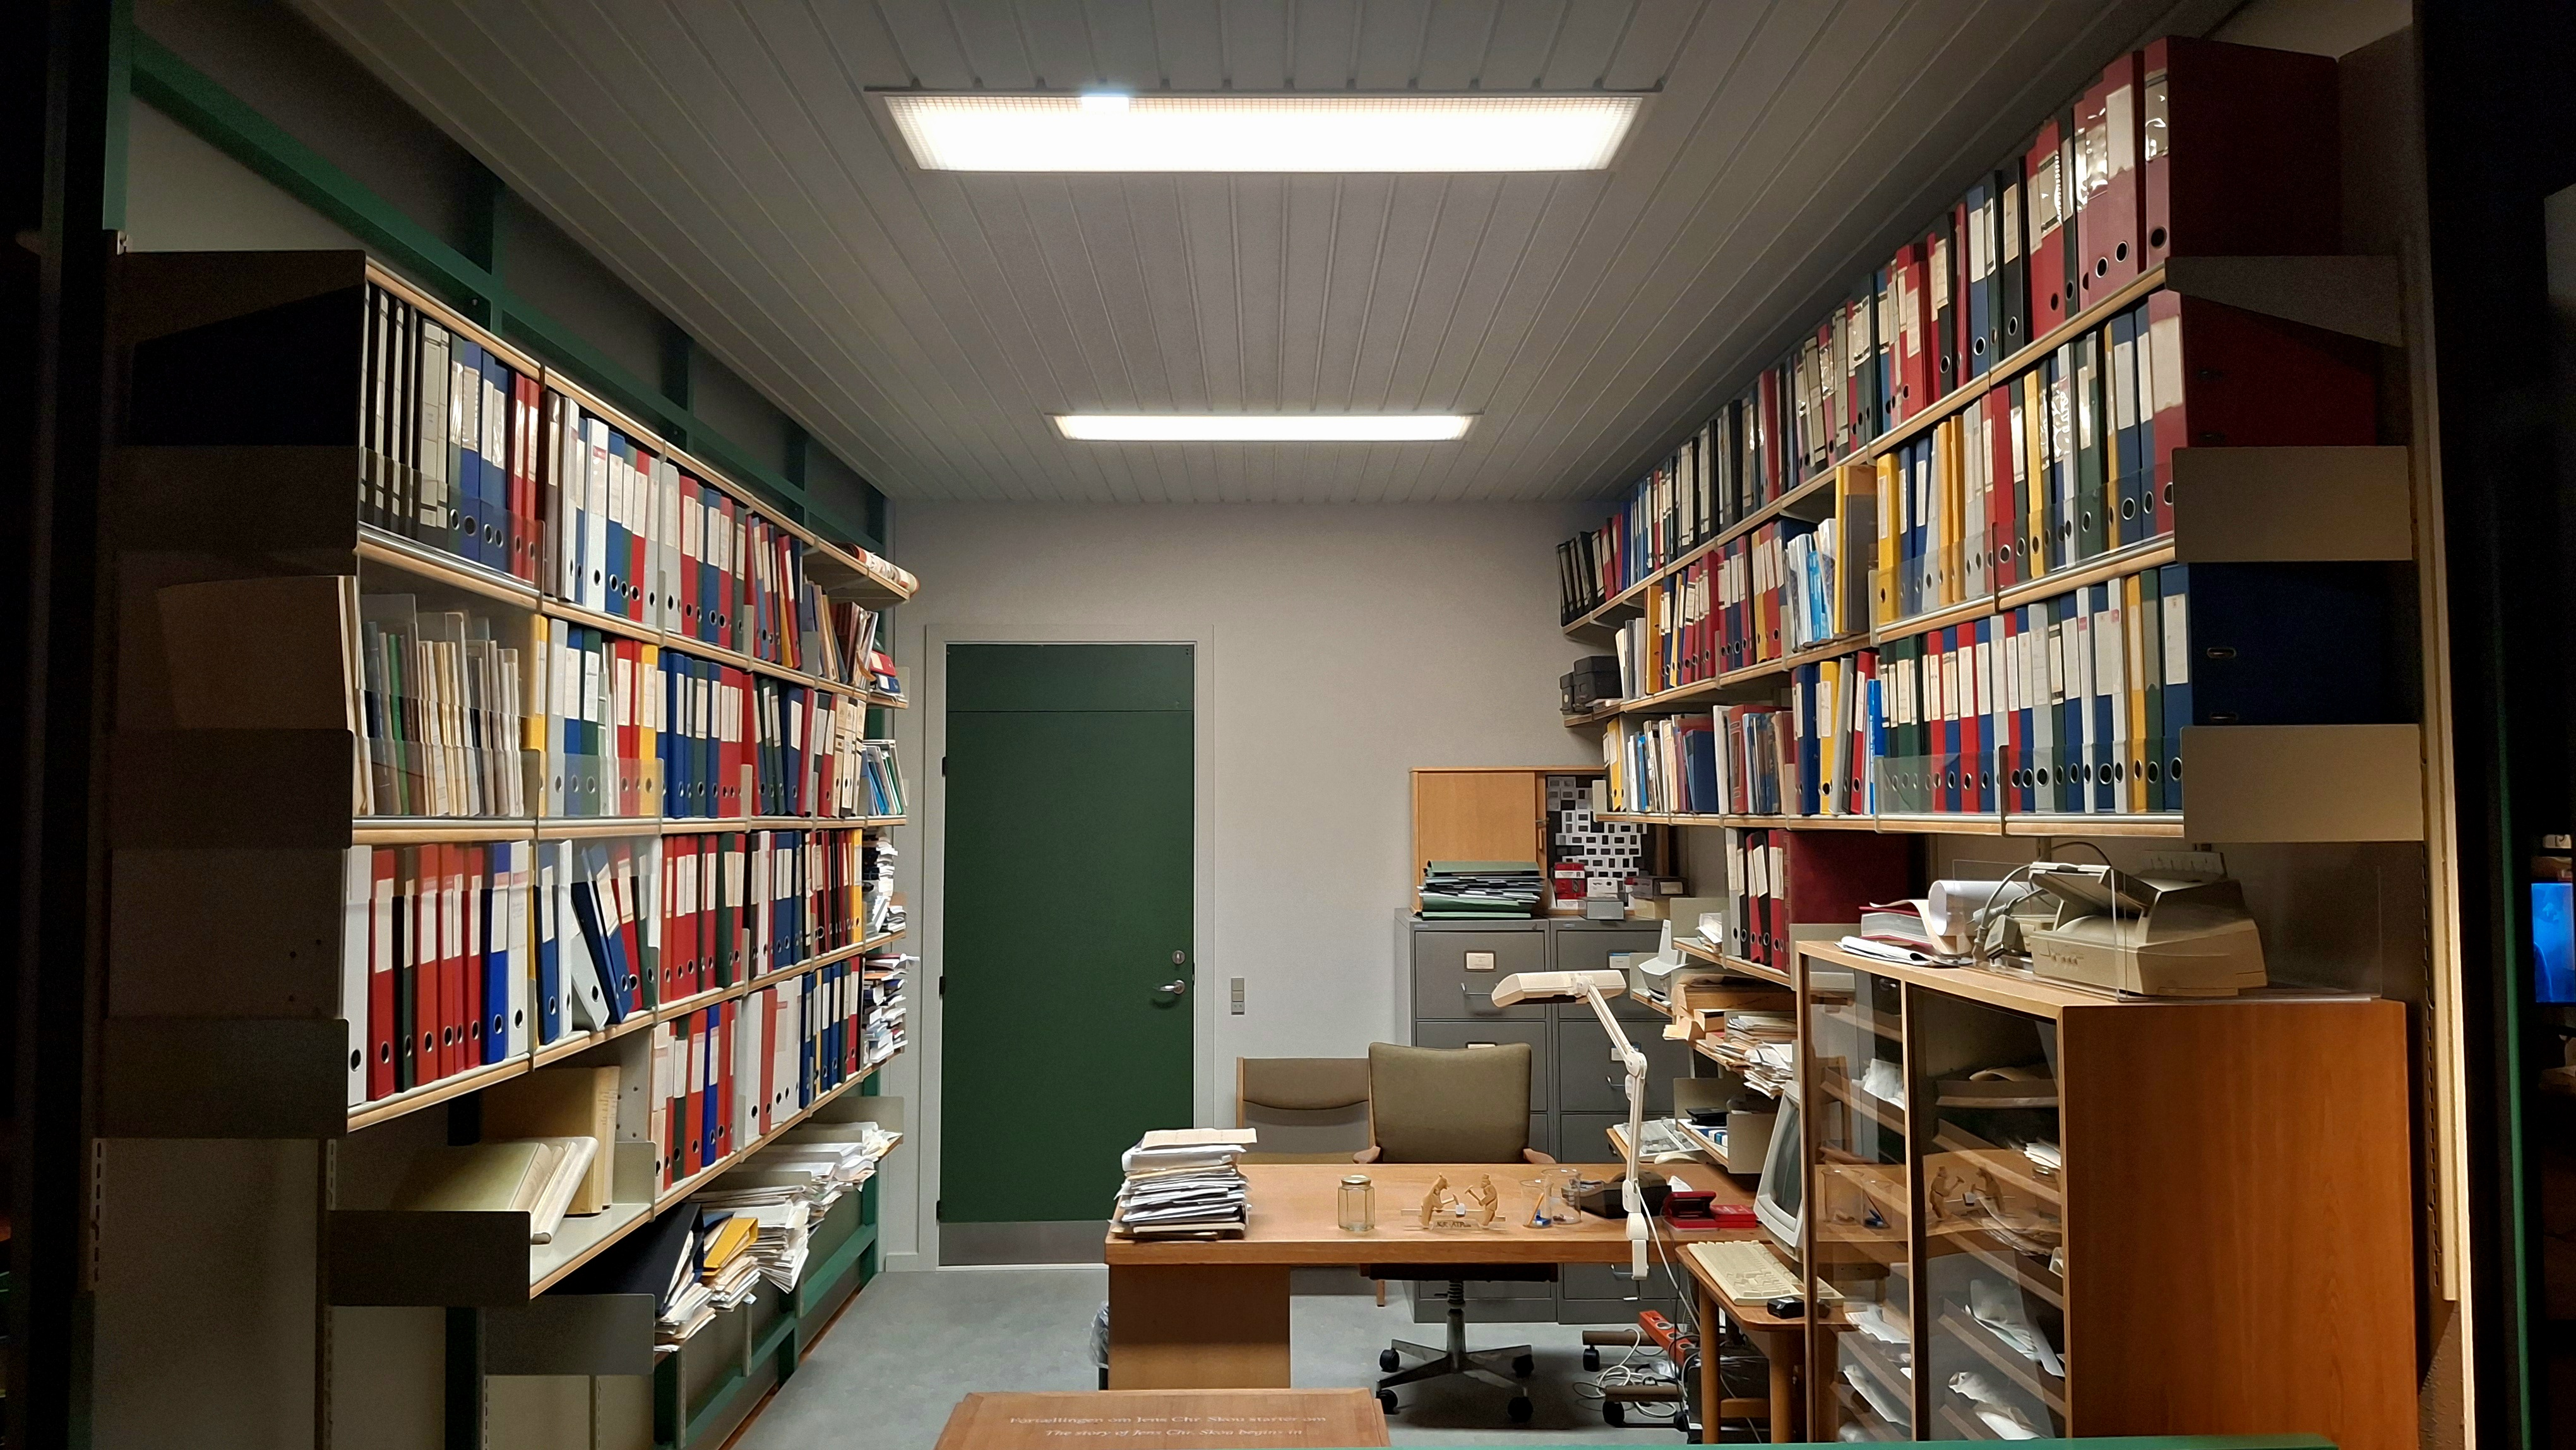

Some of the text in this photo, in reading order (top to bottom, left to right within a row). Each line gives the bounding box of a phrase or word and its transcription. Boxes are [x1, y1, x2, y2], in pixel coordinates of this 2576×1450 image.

[1136, 1416, 1168, 1424] Jens
[1131, 1429, 1162, 1437] Jens
[1238, 1428, 1284, 1437] begins
